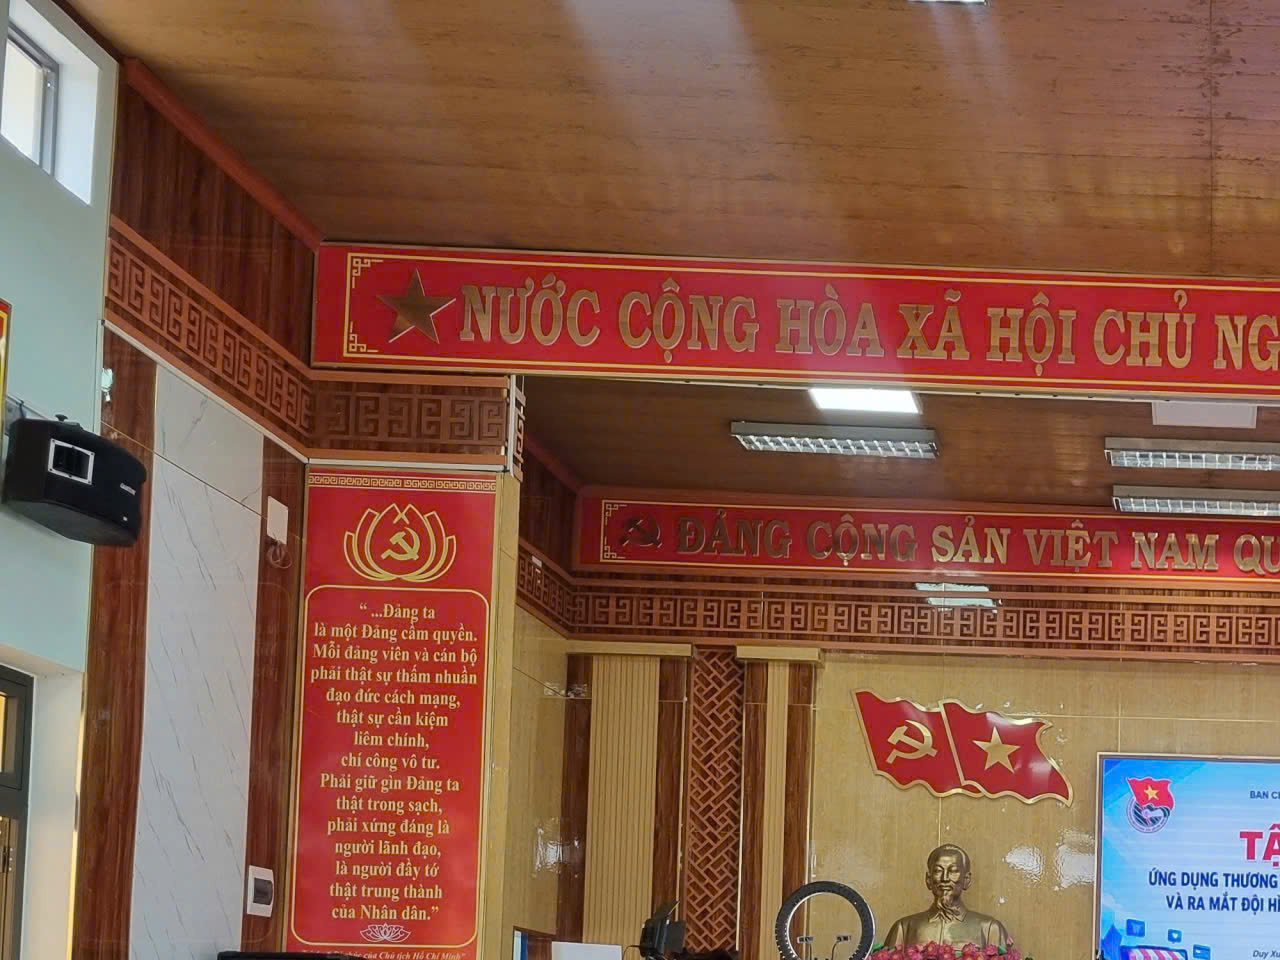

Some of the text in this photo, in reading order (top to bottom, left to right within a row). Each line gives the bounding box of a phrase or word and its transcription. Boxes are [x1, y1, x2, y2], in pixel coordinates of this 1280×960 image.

[460, 272, 600, 346] NƯỚC
[619, 278, 760, 364] CỘNG
[775, 283, 885, 357] HÒA
[897, 289, 970, 360] XÃ
[986, 290, 1077, 376] HỘI
[1093, 289, 1197, 368] CHỦ
[678, 510, 793, 560] ĐẢNG
[805, 513, 918, 567] CỘNG
[931, 515, 1010, 564] SẢN
[1022, 519, 1119, 573] VIỆT
[1131, 531, 1219, 572] NAM
[423, 607, 435, 619] ta
[314, 622, 478, 645] là một Đảng cầm quyền.
[312, 641, 478, 667] Mỗi đảng viên và cán bộ
[310, 664, 477, 686] phải thật sự thấm nhuần
[326, 688, 461, 709] đạo đức cách mạng,
[336, 707, 449, 730] thật sự cần kiệm
[354, 731, 429, 750] liêm chính,
[341, 752, 440, 772] chí công vô tư.
[320, 773, 460, 795] Phải giữ gìn Đảng ta
[1249, 791, 1268, 800] BAN
[1149, 868, 1177, 887] ỨNG
[1181, 872, 1219, 890] DỤNG
[1223, 871, 1278, 889] THƯƠNG
[1166, 892, 1184, 910] VÀ
[1187, 896, 1205, 911] RA
[1209, 891, 1238, 911] MẮT
[1241, 894, 1264, 915] ĐỘI
